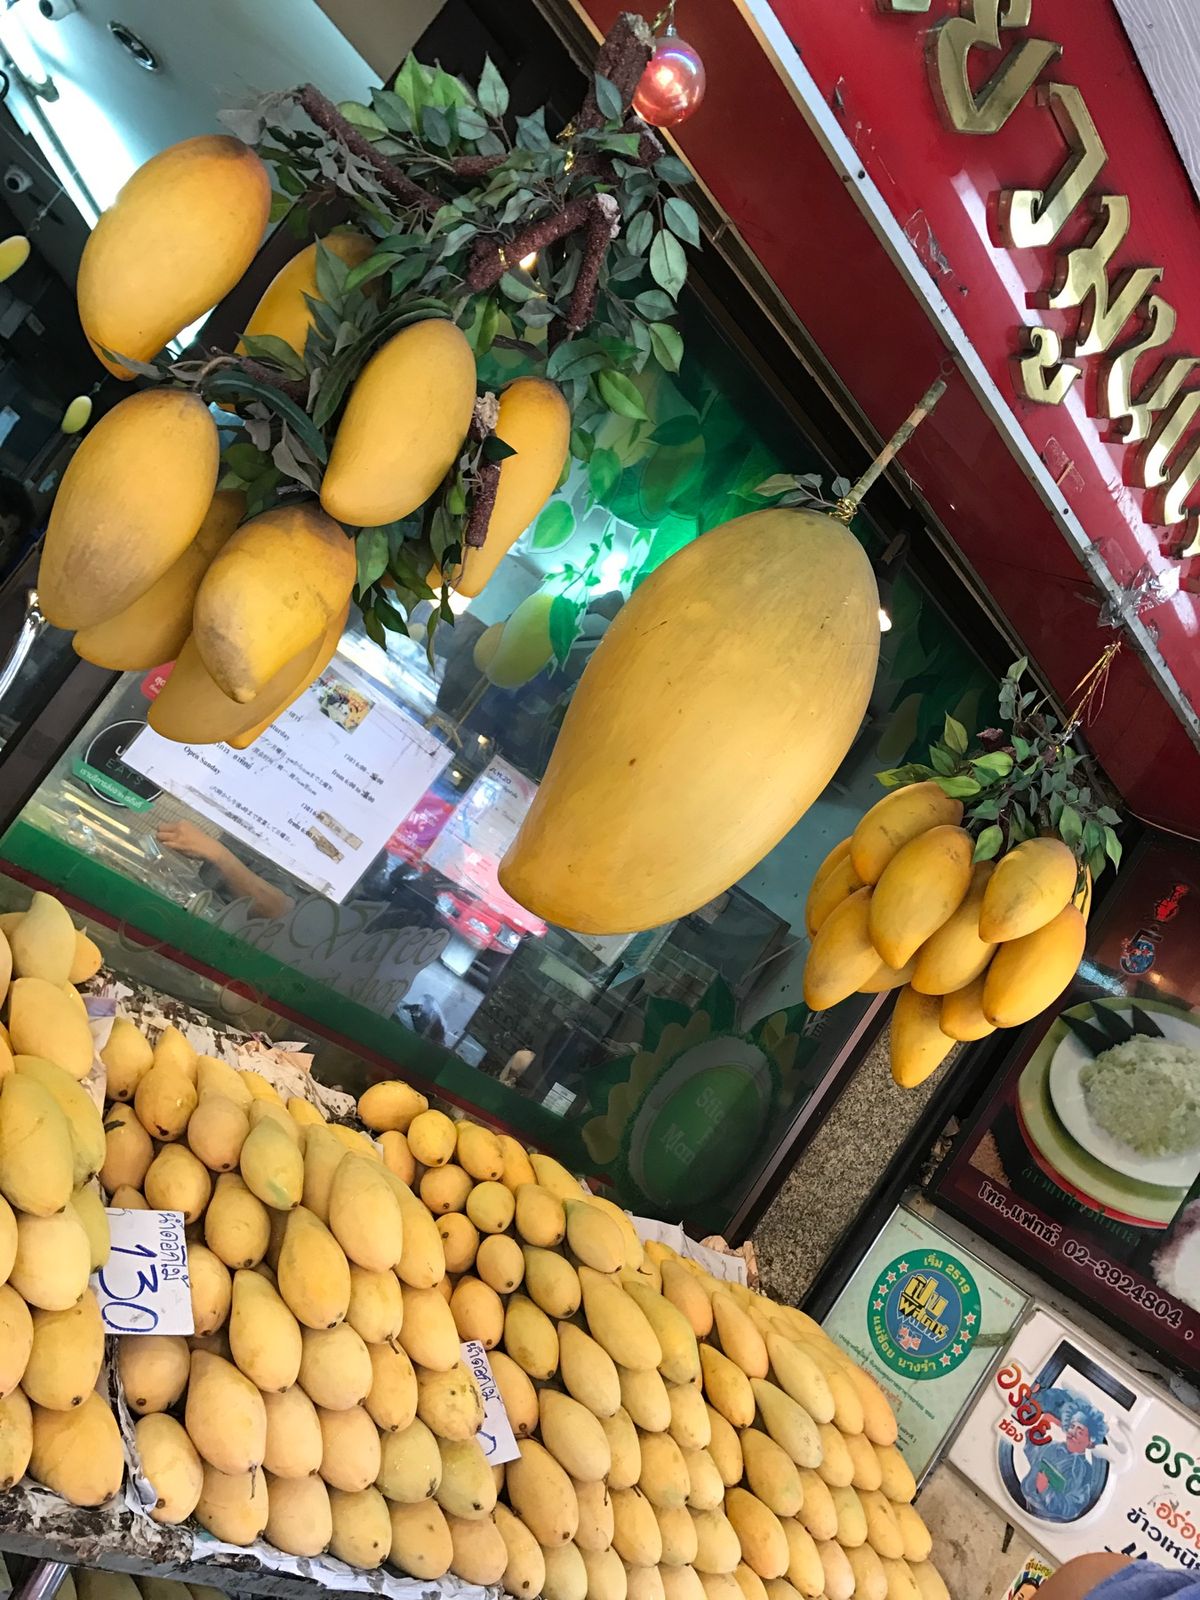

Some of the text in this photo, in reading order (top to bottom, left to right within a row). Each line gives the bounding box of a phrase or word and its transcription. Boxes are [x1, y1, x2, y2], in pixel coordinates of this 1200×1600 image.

[105, 757, 144, 785] EATS
[183, 745, 200, 760] Open
[200, 757, 221, 775] Sunday
[289, 891, 450, 968] Varee
[97, 1243, 159, 1333] 130
[945, 1263, 971, 1294] 2519
[1062, 1239, 1184, 1329] 02-3924804
[1126, 1505, 1200, 1571] ข้าวเหนี
